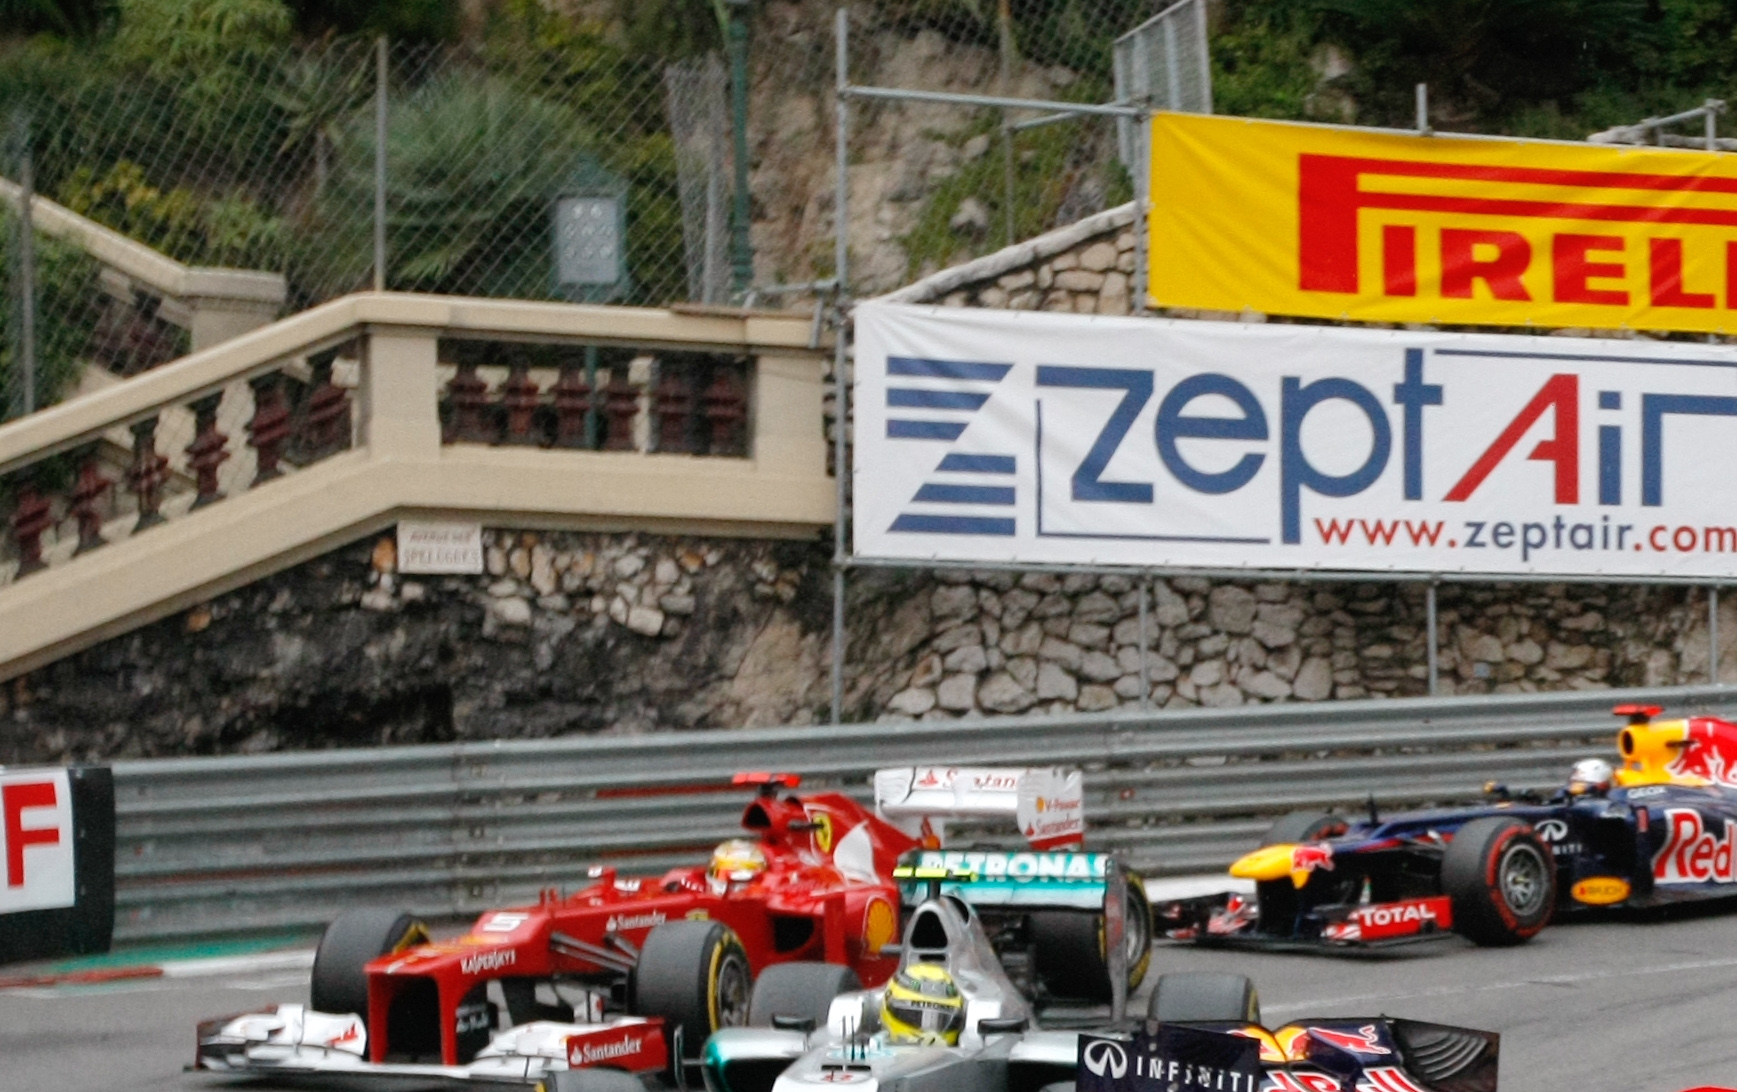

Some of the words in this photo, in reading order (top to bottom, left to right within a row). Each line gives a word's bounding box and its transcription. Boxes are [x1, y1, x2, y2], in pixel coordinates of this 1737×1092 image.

[3, 782, 60, 889] F
[1652, 808, 1734, 884] Red
[617, 909, 667, 929] Santander
[1358, 902, 1436, 927] TOTAL
[583, 1035, 642, 1061] Santander
